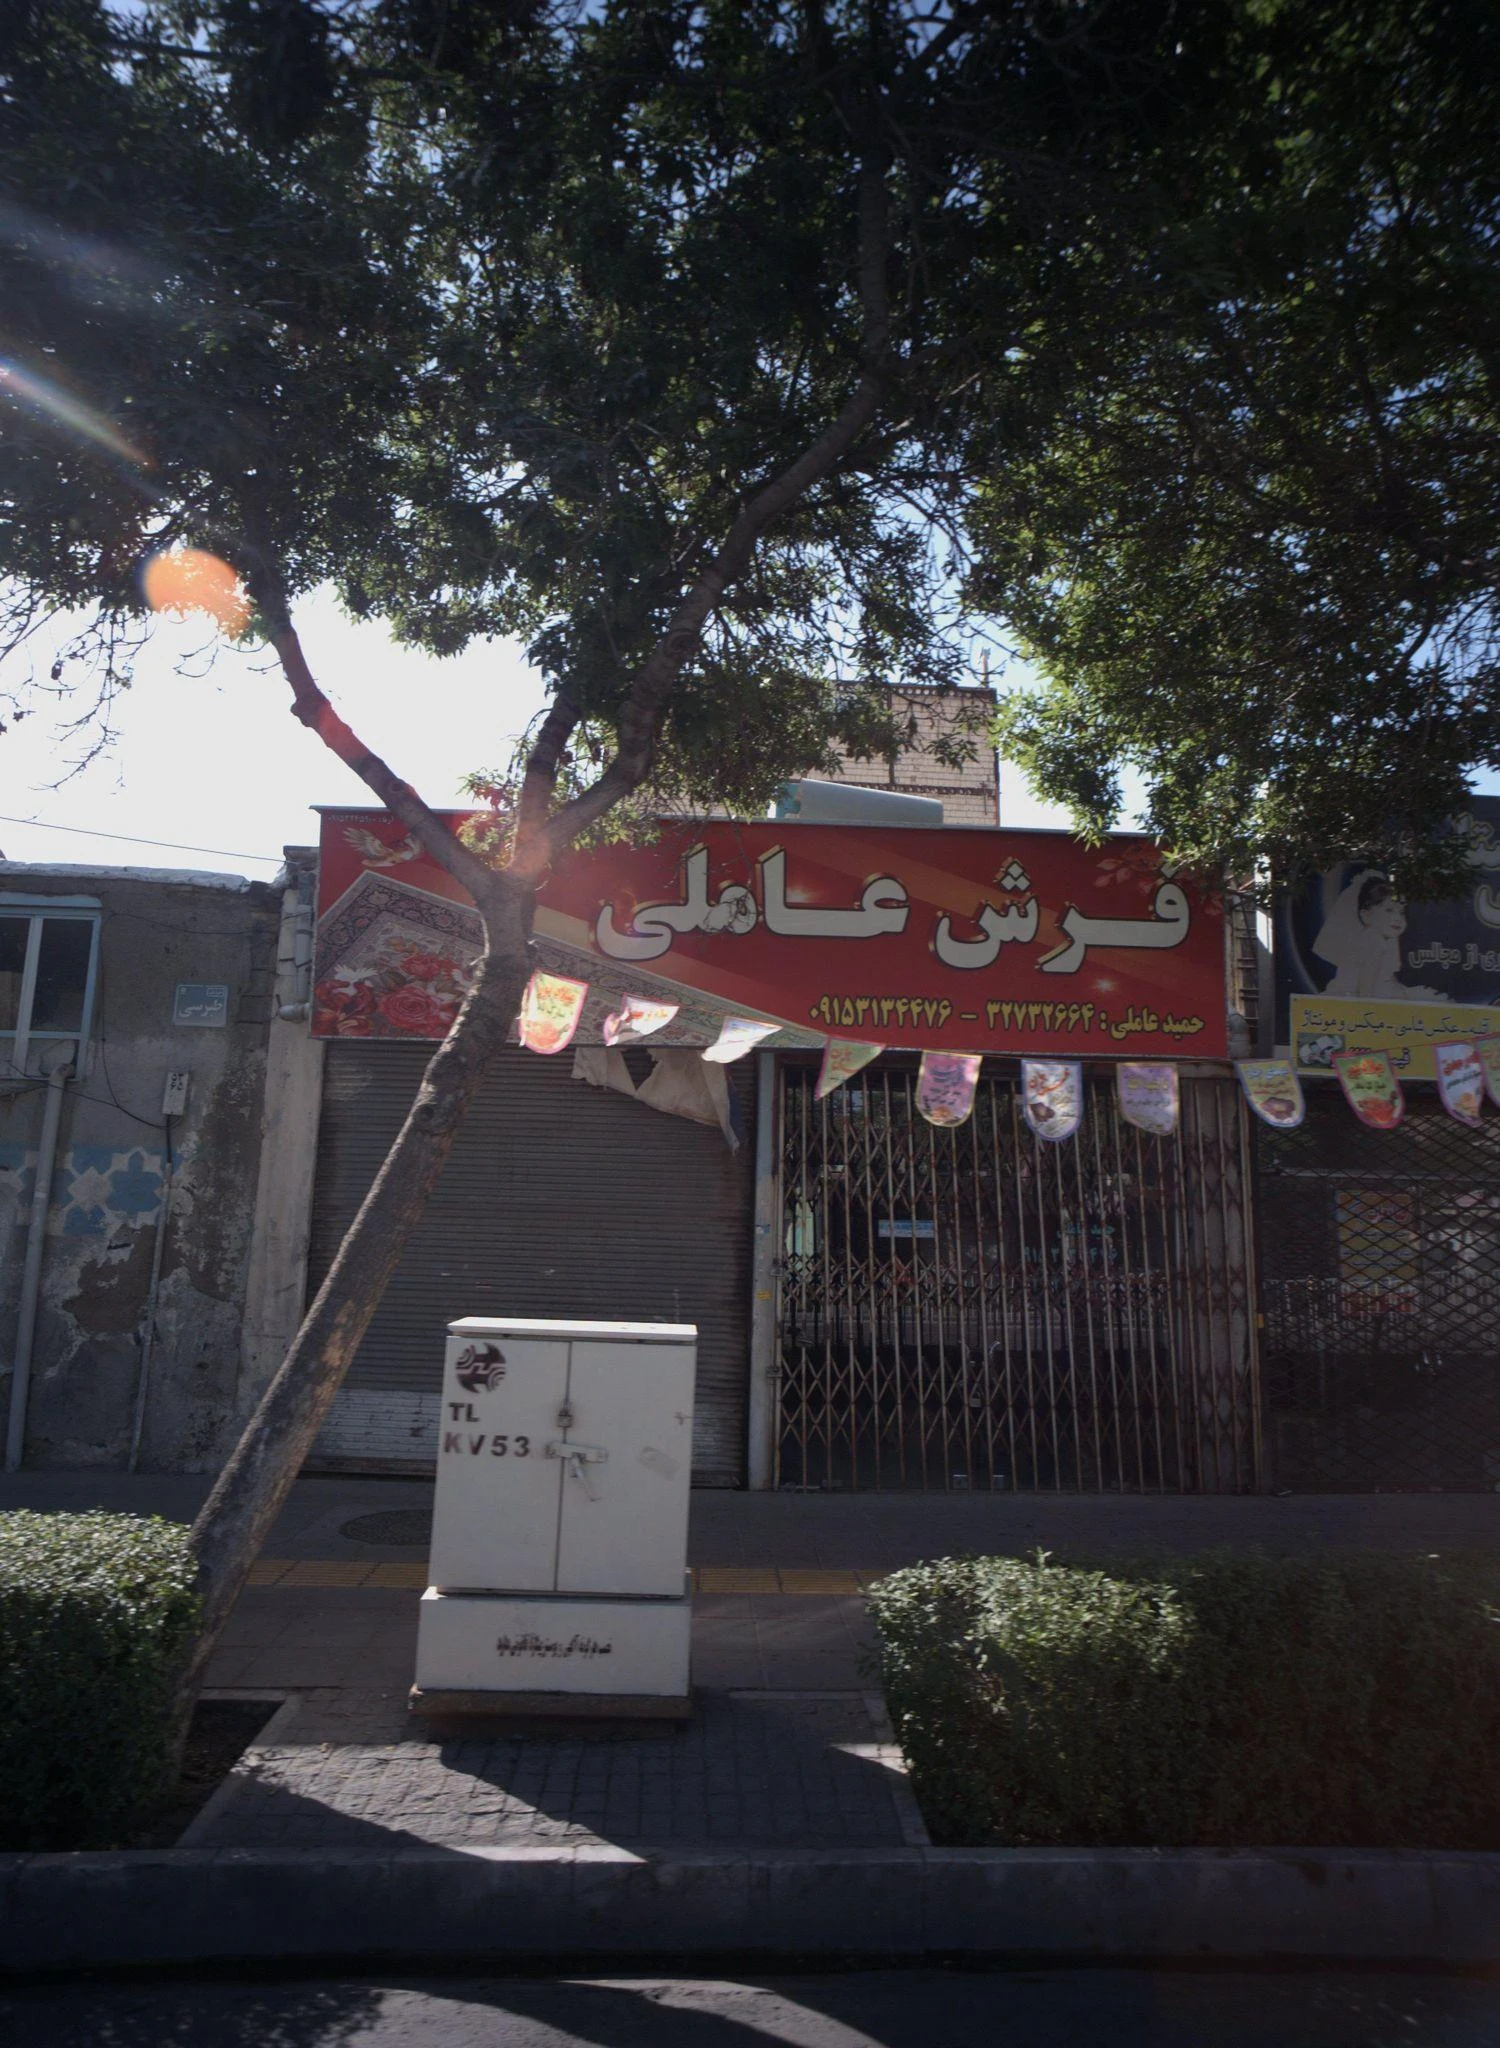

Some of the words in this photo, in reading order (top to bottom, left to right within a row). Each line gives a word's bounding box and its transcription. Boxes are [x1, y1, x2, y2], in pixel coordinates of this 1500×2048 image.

[597, 846, 910, 962] عاملی
[934, 858, 1190, 973] فرش
[1408, 941, 1462, 969] مجالس
[179, 999, 224, 1018] طبرسی
[809, 993, 953, 1028] ۰۹۱۵۳۱۳۴۴۷۶
[986, 999, 1095, 1033] ۳۲۷۳۲۶۶۴
[1162, 1014, 1205, 1040] حمید
[448, 1402, 480, 1422] TL
